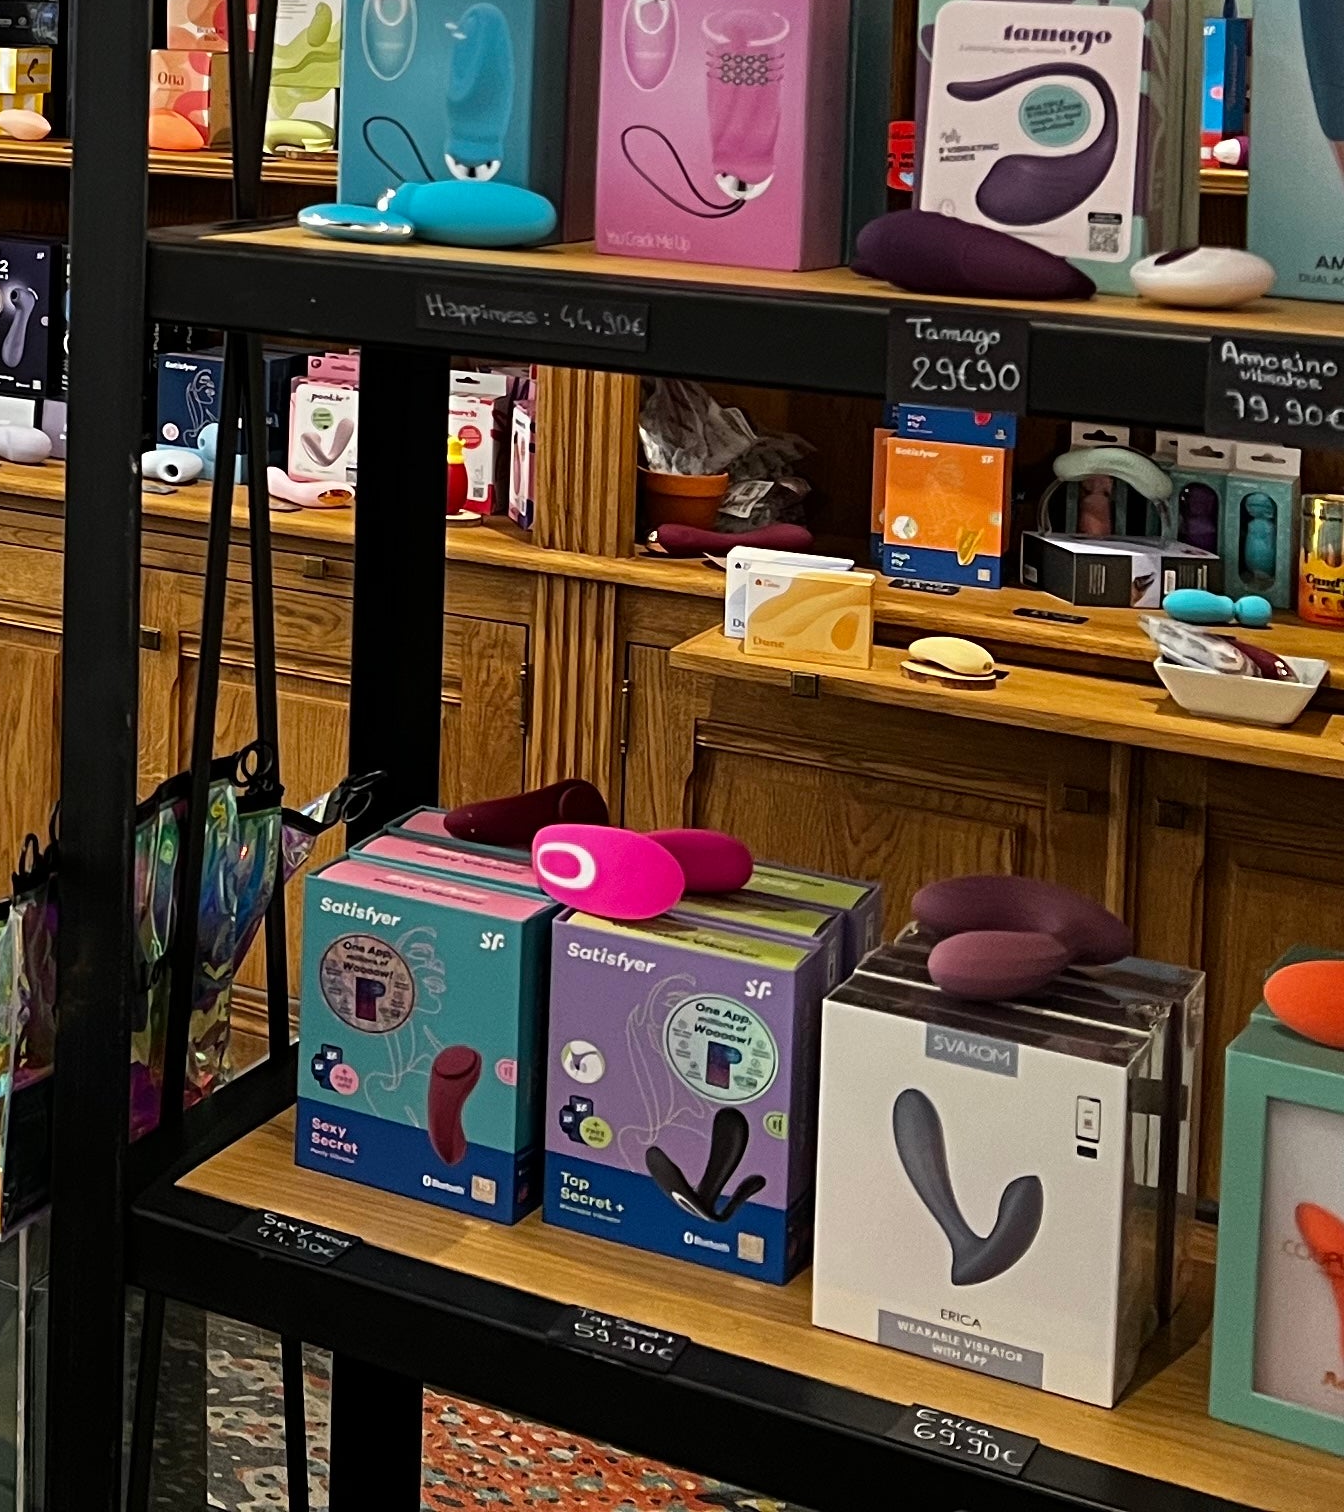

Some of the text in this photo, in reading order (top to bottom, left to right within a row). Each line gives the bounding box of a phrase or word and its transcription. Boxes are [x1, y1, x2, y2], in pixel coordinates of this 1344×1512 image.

[1004, 24, 1112, 55] tamago
[157, 71, 185, 86] Ona
[0, 259, 9, 272] 2
[906, 316, 1002, 355] Tamago
[1221, 340, 1338, 377] Amorino
[910, 354, 1021, 393] 29€90
[320, 896, 401, 927] Satisfyer
[342, 941, 365, 953] One
[566, 942, 657, 974] Satisfyer
[696, 1002, 721, 1017] One
[933, 1034, 1010, 1066] SVAKOM
[312, 1117, 346, 1139] Sexy
[311, 1132, 359, 1156] Secret
[560, 1171, 590, 1190] Top
[560, 1187, 613, 1211] Secret
[940, 1308, 982, 1330] ERICA
[897, 1320, 1023, 1362] WEARABLE VIBRATOR
[932, 1343, 987, 1367] WITH APP
[916, 1408, 994, 1439] Erica
